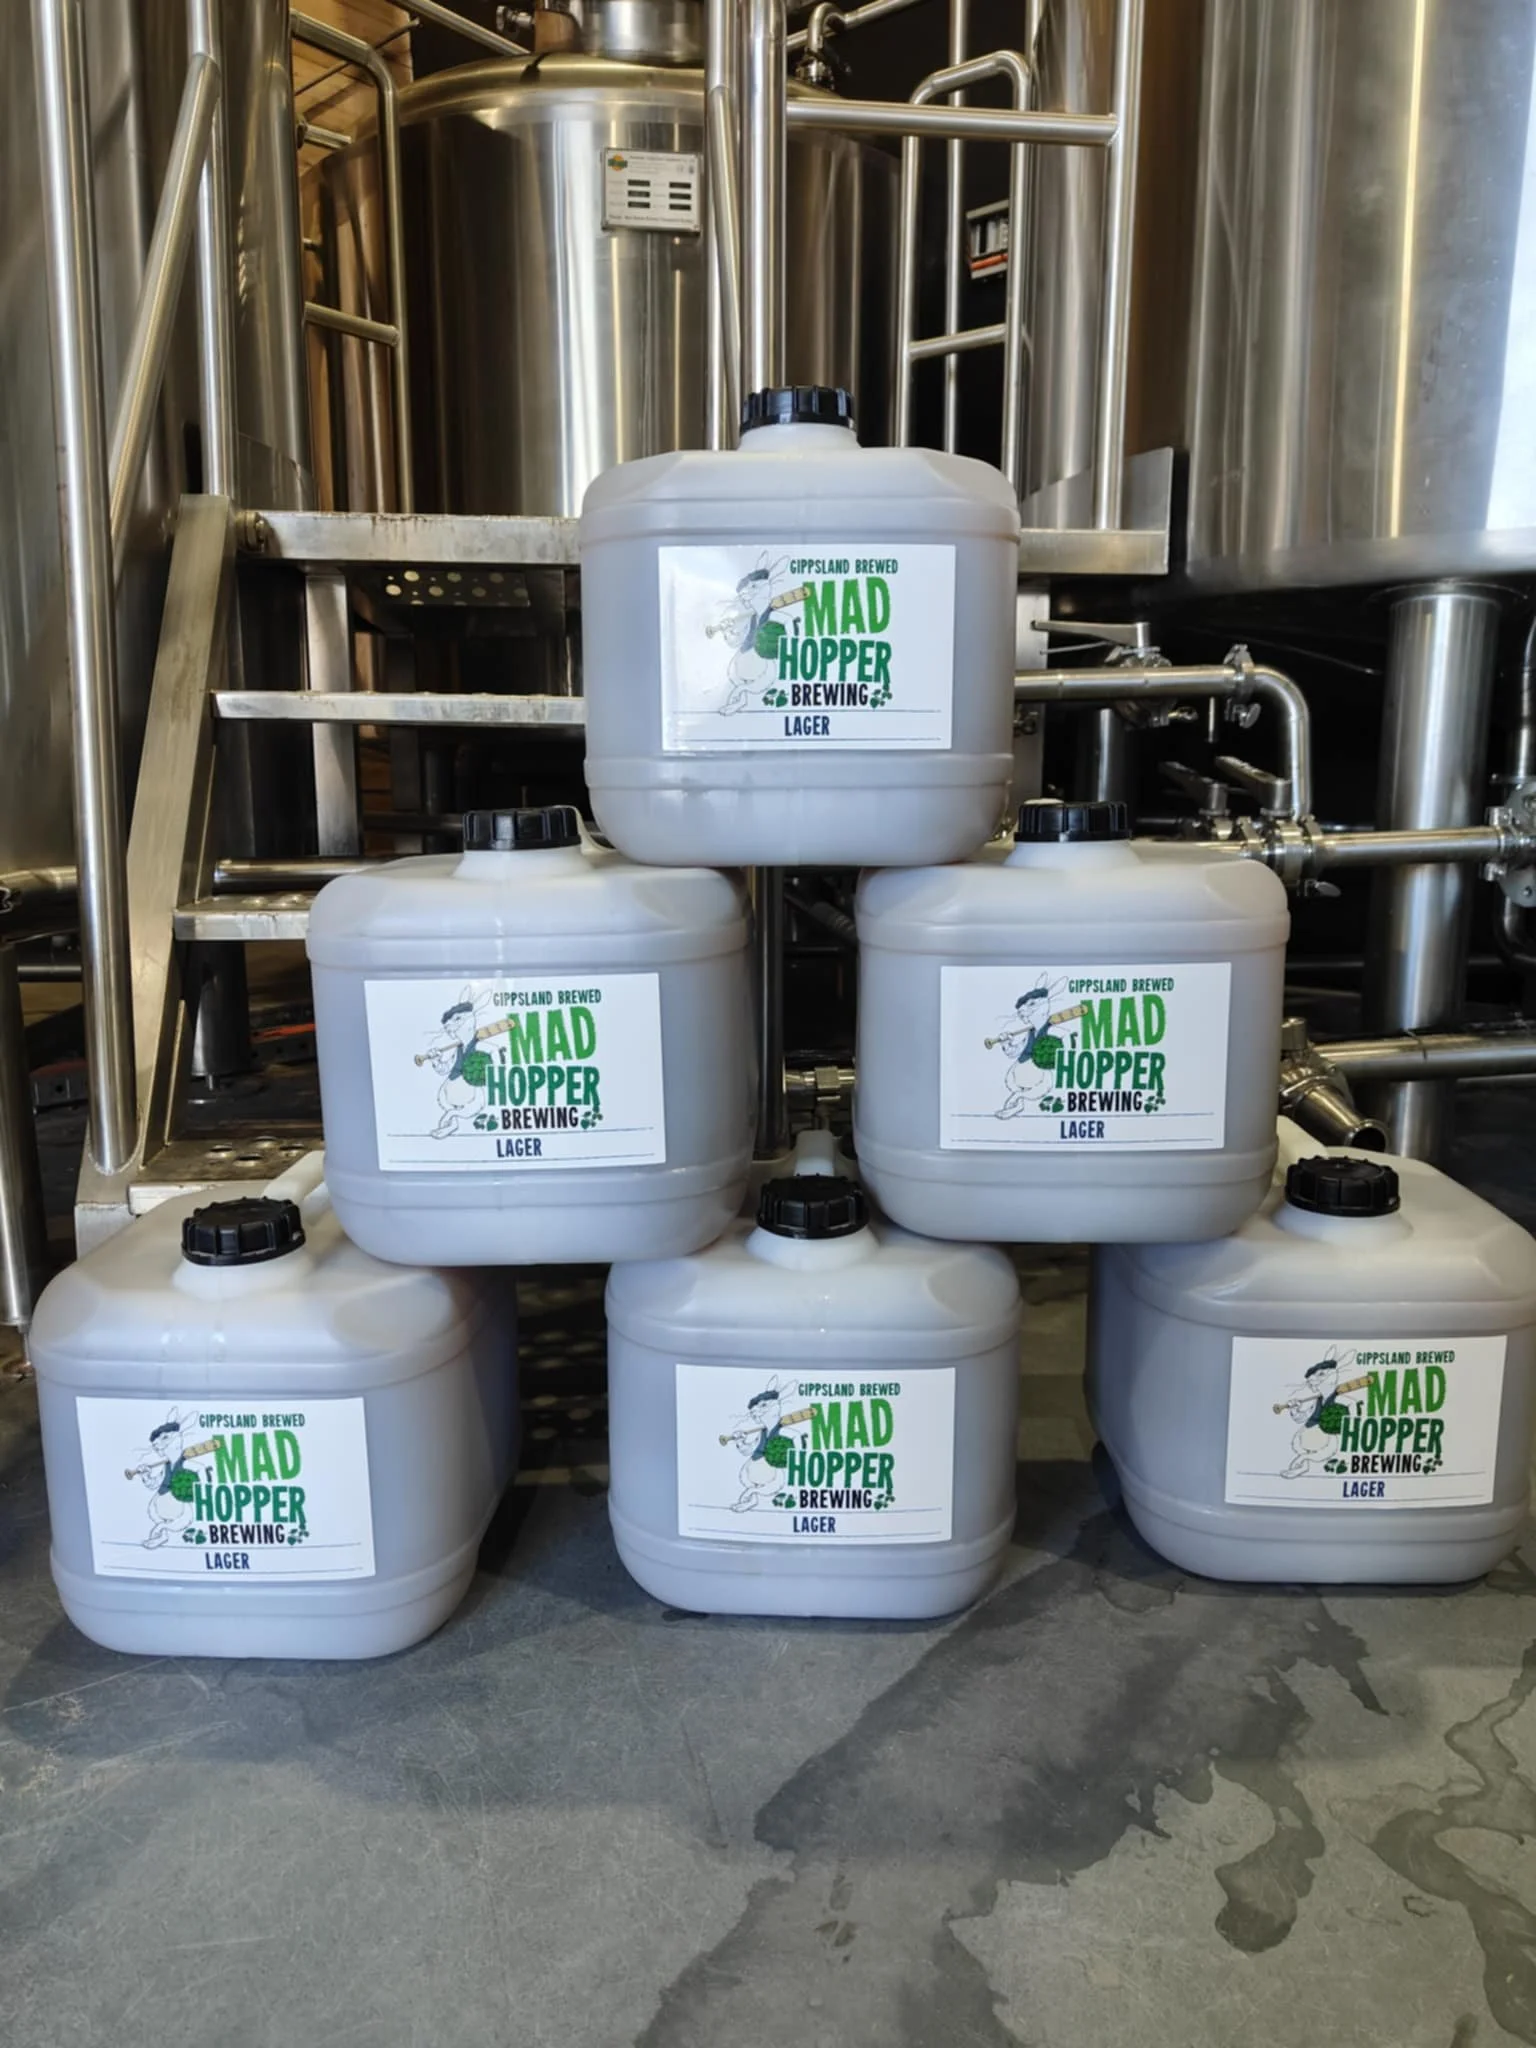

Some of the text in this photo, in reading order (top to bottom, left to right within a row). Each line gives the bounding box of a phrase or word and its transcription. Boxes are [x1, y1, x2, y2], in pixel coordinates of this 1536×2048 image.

[790, 559, 898, 574] GIPPSLAND BREWED
[802, 577, 891, 636] MAD
[778, 637, 892, 691] HOPPER
[791, 683, 868, 708] BREWING
[785, 716, 830, 736] LAGER
[1068, 977, 1174, 993] GIPPSLAND BREWED
[493, 989, 601, 1006] GIPPSLAND BREWED
[1080, 994, 1165, 1050] MAD
[507, 1007, 596, 1065] MAD
[1055, 1050, 1165, 1096] HOPPER
[487, 1066, 600, 1112] HOPPER
[1067, 1091, 1143, 1112] BREWING
[501, 1107, 578, 1130] BREWING
[1060, 1120, 1105, 1139] LAGER
[497, 1138, 542, 1157] LAGER
[1356, 1350, 1455, 1364] GIPPSLAND BREWED
[798, 1383, 900, 1397] GIPPSLAND BREWED
[1367, 1366, 1446, 1417] MAD
[199, 1414, 305, 1428] GIPPSLAND BREWED
[809, 1398, 894, 1450] MAD
[1340, 1417, 1444, 1458] HOPPER
[212, 1429, 301, 1483] MAD
[1351, 1455, 1422, 1474] BREWING
[787, 1451, 894, 1494] HOPPER
[799, 1489, 872, 1509] BREWING
[1343, 1481, 1385, 1498] LAGER
[195, 1484, 306, 1529] HOPPER
[209, 1524, 285, 1544] BREWING
[793, 1516, 836, 1533] LAGER
[205, 1552, 250, 1570] LAGER
